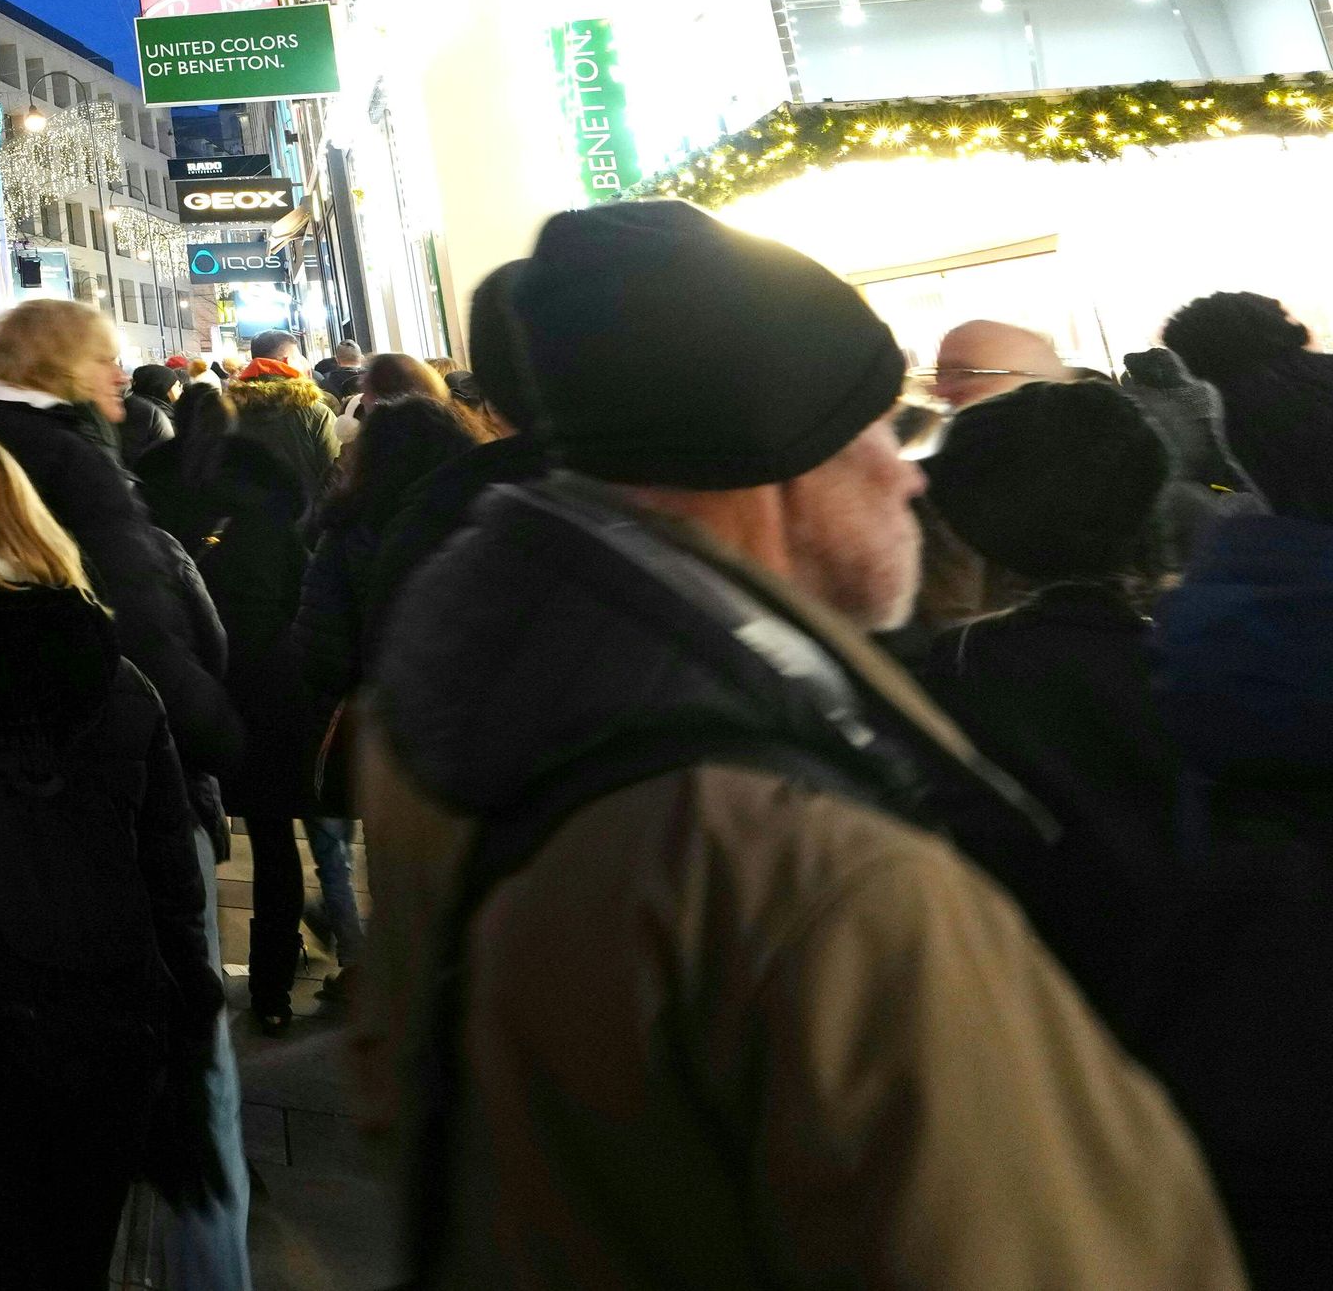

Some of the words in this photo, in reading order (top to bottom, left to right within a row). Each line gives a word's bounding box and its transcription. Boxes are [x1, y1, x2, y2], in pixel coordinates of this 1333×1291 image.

[146, 40, 216, 59] UNITED
[221, 33, 299, 53] COLORS
[148, 61, 173, 77] OF
[178, 54, 285, 75] BENETTON.
[186, 161, 223, 171] RADO
[183, 190, 289, 211] GEOX
[221, 255, 282, 271] IQOS
